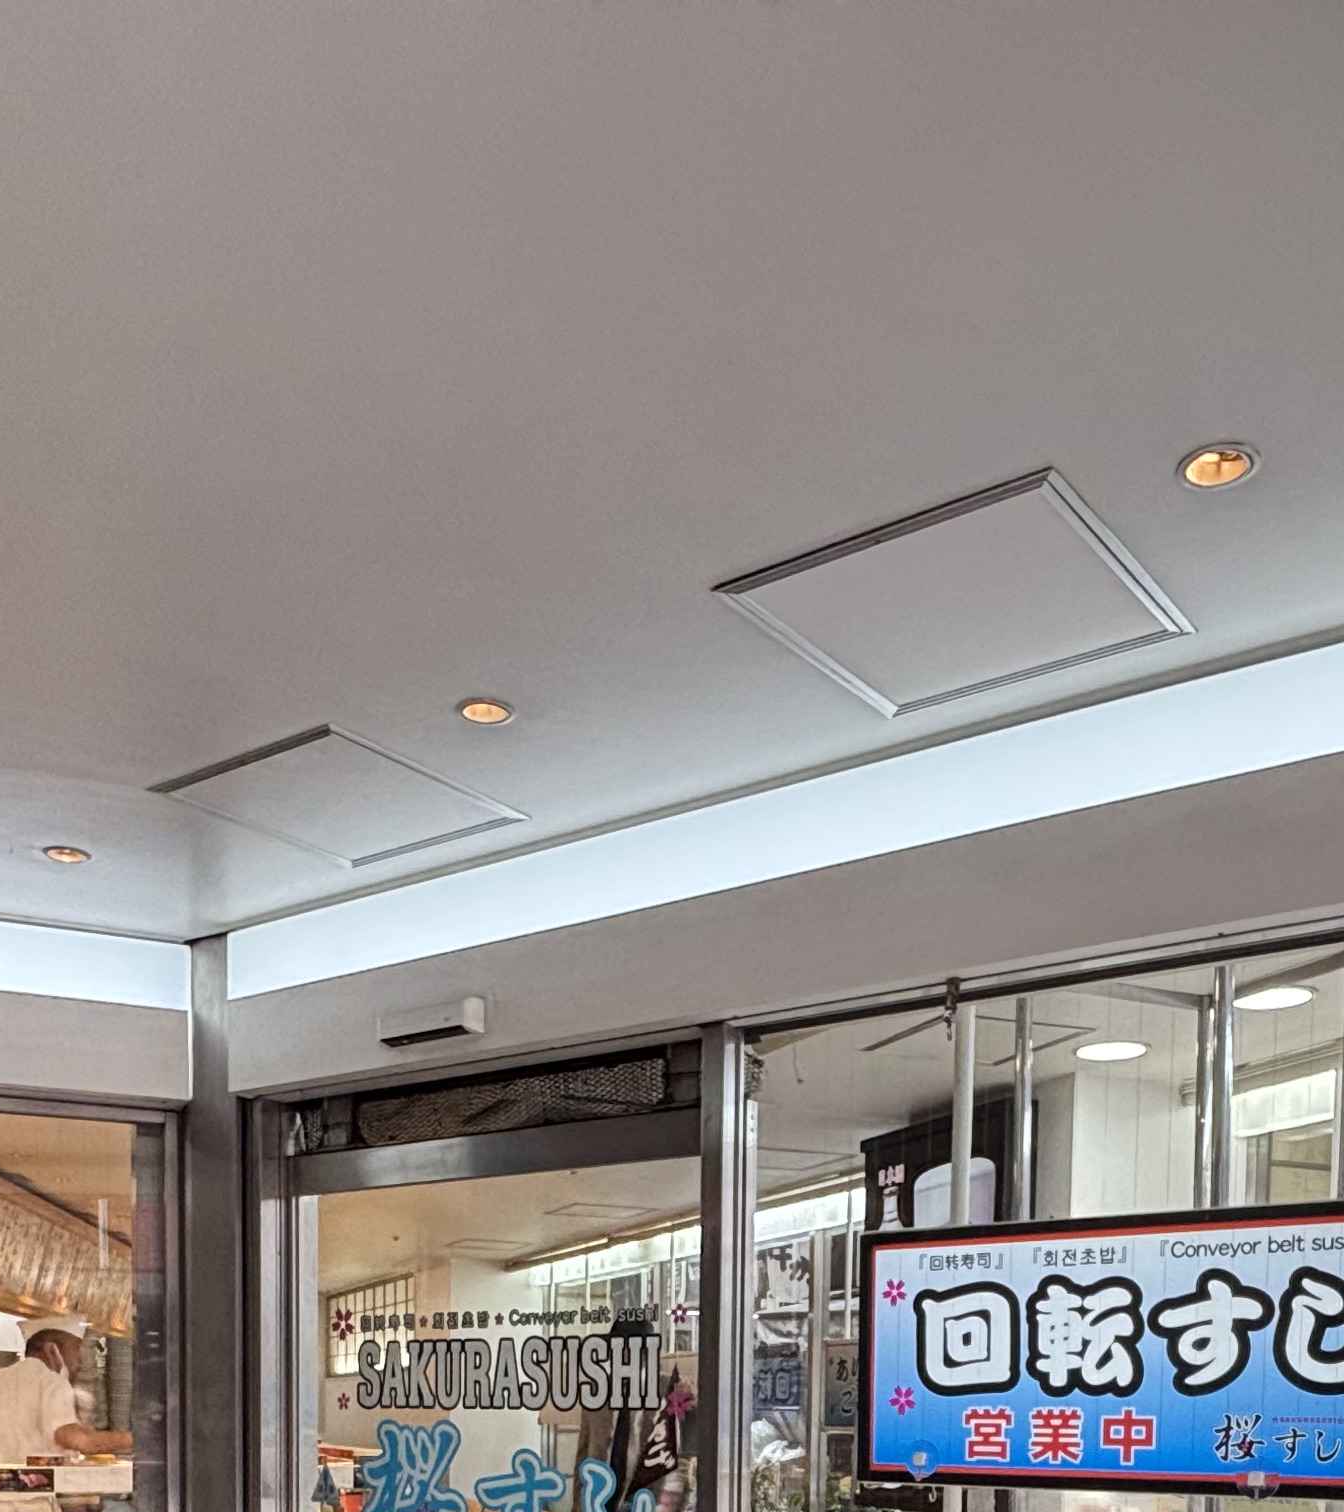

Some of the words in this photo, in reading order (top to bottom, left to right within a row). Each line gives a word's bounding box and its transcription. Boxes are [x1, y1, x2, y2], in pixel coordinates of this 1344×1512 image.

[1267, 1235, 1306, 1253] belt
[508, 1308, 577, 1329] Conveyor
[580, 1306, 611, 1324] belt
[618, 1304, 659, 1322] sushi
[357, 1334, 662, 1411] SAKURASUSHI
[962, 1407, 1155, 1466] 営業中
